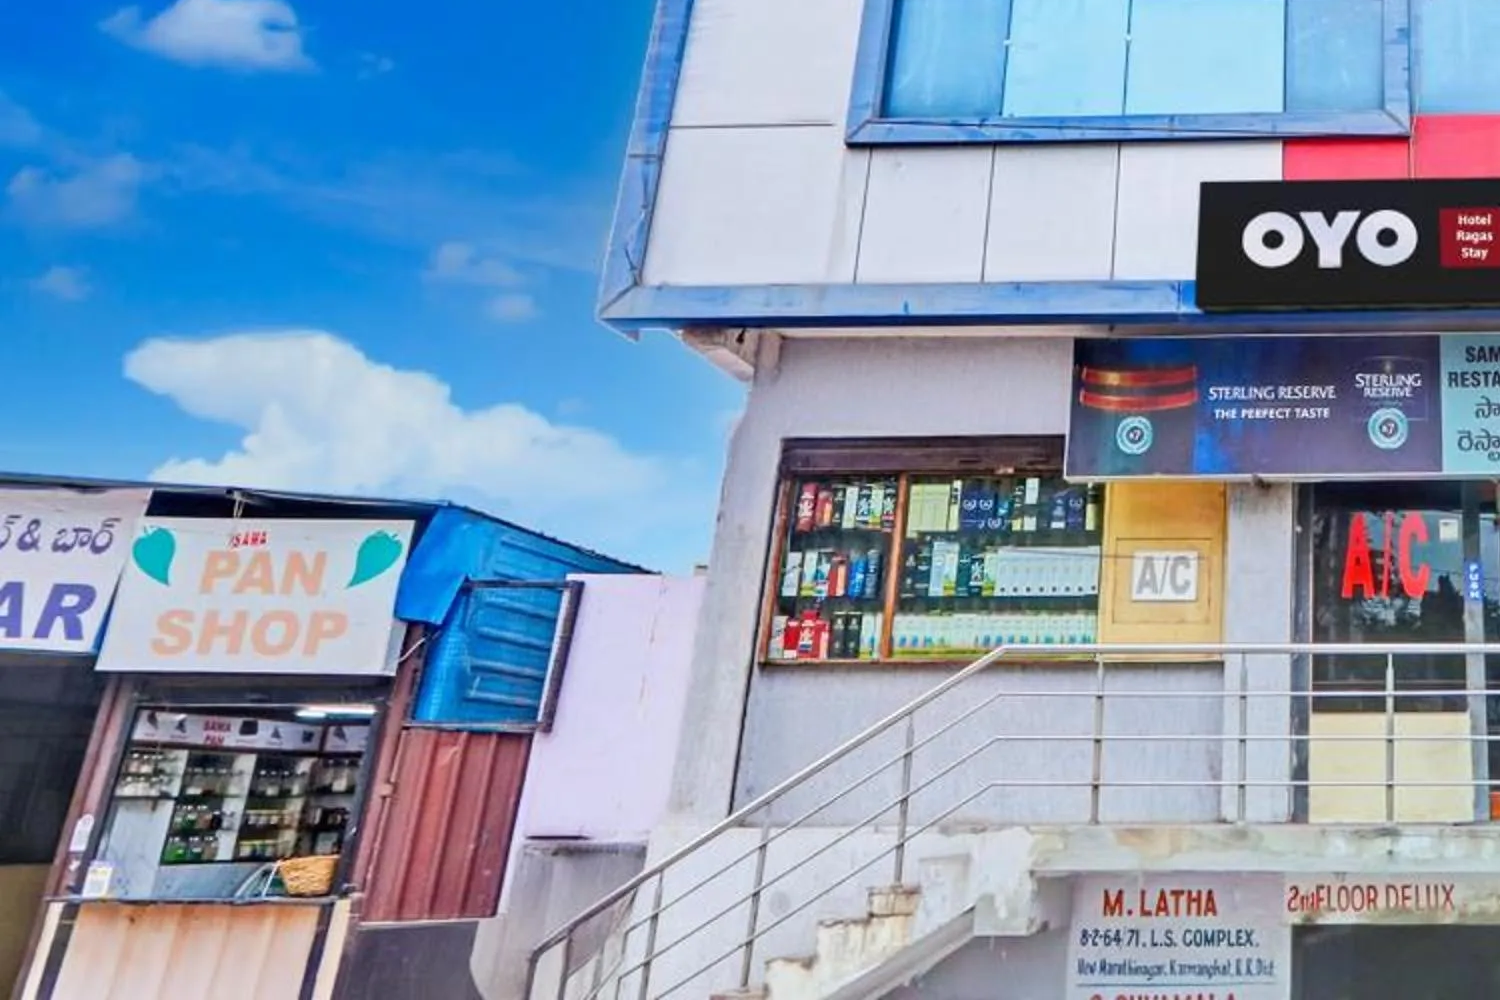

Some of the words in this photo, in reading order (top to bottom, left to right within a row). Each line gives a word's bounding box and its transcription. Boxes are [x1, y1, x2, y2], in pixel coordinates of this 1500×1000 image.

[1458, 213, 1492, 225] Hotel
[1242, 209, 1418, 268] OYO
[1456, 230, 1493, 245] Ragas
[1461, 247, 1488, 260] Stay
[1208, 386, 1275, 400] STERLING
[1278, 385, 1337, 399] RESERVE
[1355, 373, 1422, 388] STERLING
[1214, 408, 1239, 419] THE
[1241, 408, 1292, 419] PERFECT
[1294, 407, 1330, 419] TASTE
[17, 518, 41, 552] &
[1340, 510, 1430, 600] A/C
[200, 550, 327, 596] PAN
[1136, 556, 1193, 595] A/C
[151, 609, 349, 658] SHOP
[1385, 884, 1455, 912] DELUX
